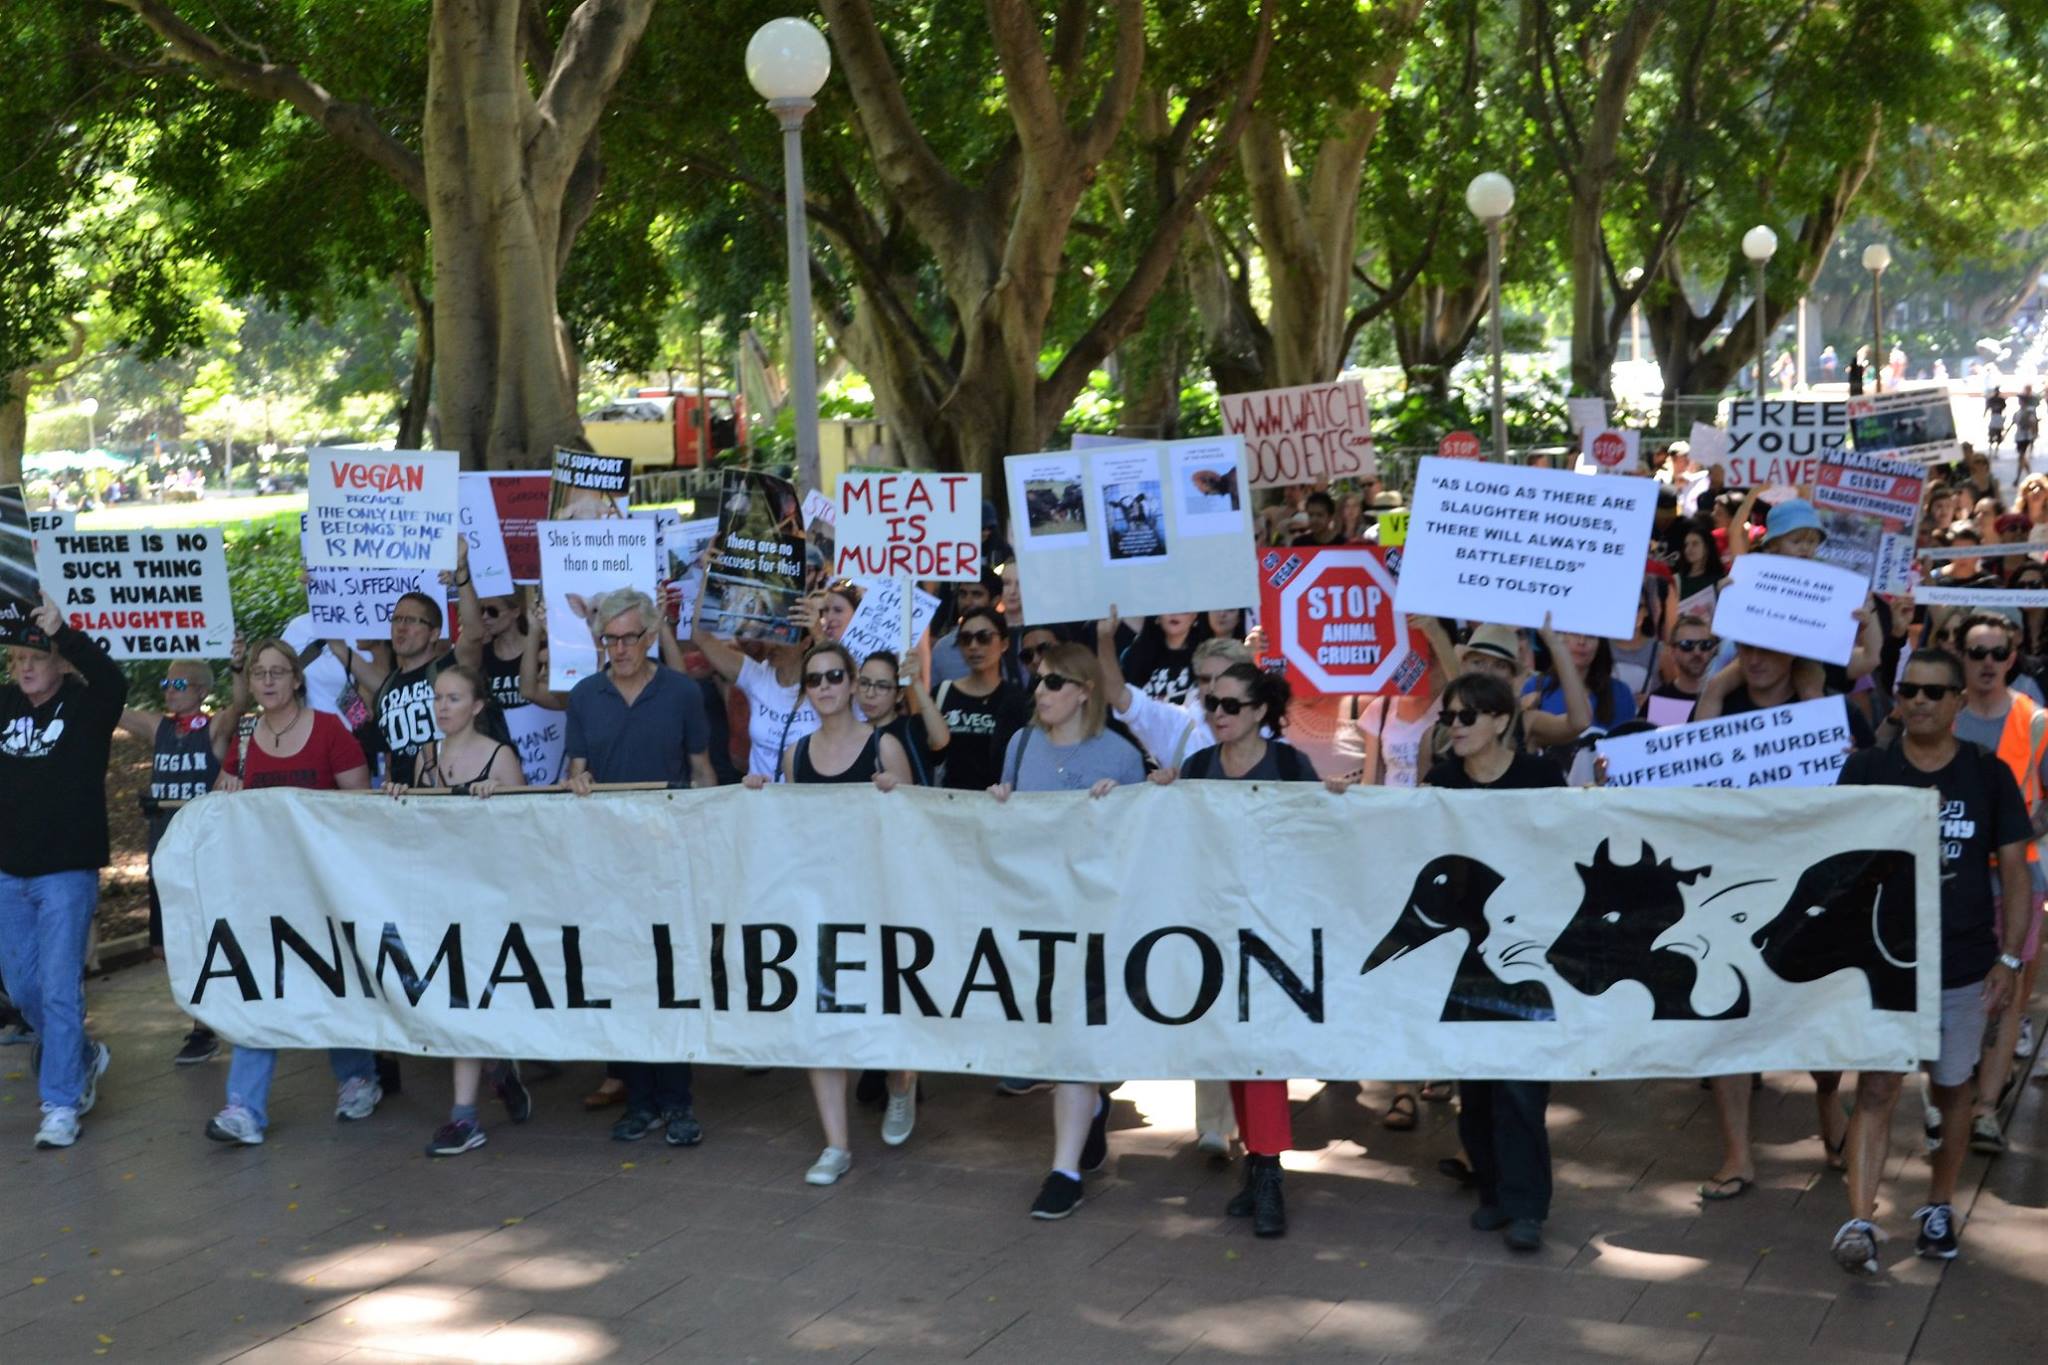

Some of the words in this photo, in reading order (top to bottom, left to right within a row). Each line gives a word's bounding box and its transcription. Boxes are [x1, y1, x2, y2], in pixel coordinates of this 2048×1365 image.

[1731, 402, 1846, 426] FREE
[571, 453, 623, 473] SUPPORT
[1847, 452, 1926, 479] MARCHING
[574, 471, 625, 490] SLAVERY
[1850, 474, 1887, 491] CLOSE
[843, 476, 968, 515] MEAT
[1465, 481, 1509, 497] LONG
[1515, 486, 1536, 500] AS
[1543, 490, 1596, 507] THERE
[1600, 497, 1636, 512] ARE
[317, 506, 344, 519] THE
[347, 508, 386, 522] ONLY
[424, 511, 454, 525] THAT
[1440, 500, 1539, 522] SLAUGHTER
[1545, 512, 1618, 534] HOUSES,
[321, 521, 395, 536] BELONGS
[420, 526, 444, 541] ME
[548, 530, 568, 548] She
[572, 531, 581, 546] is
[585, 529, 614, 546] much
[618, 534, 647, 546] more
[886, 514, 927, 544] IS
[1426, 521, 1479, 539] THERE
[1484, 528, 1522, 544] WILL
[1528, 535, 1597, 553] ALWAYS
[1603, 543, 1625, 556] BE
[55, 535, 129, 553] THERE
[141, 534, 164, 552] IS
[177, 533, 208, 552] NO
[326, 538, 346, 557] IS
[353, 538, 384, 560] MY
[386, 542, 432, 561] OWN
[727, 531, 755, 552] there
[758, 542, 776, 554] are
[778, 544, 793, 556] no
[63, 562, 122, 579] SUCH
[134, 560, 202, 578] THING
[564, 554, 587, 571] than
[592, 558, 598, 571] a
[602, 554, 633, 572] meal.
[719, 555, 755, 571] xcuses
[758, 554, 774, 572] for
[777, 557, 801, 576] this!
[837, 542, 978, 576] MURDER
[67, 587, 95, 605] AS
[111, 586, 203, 604] HUMANE
[1458, 572, 1490, 587] LEO
[1496, 577, 1573, 598] TOLSTOY
[1755, 582, 1777, 593] OUR
[1812, 582, 1835, 593] ARE
[311, 604, 350, 624] FEAR
[355, 601, 369, 626] &
[375, 603, 396, 623] DE
[1307, 586, 1382, 620] STOP
[69, 612, 206, 631] SLAUGHTER
[1322, 623, 1376, 643] ANIMAL
[124, 635, 200, 653] VEGAN
[1317, 646, 1382, 665] CRUELTY
[1645, 715, 1765, 755] SUFFERING
[1772, 709, 1793, 728] IS
[1607, 752, 1723, 788] SUFFERING
[1732, 747, 1748, 763] &
[1754, 726, 1846, 759] MURDER
[1748, 764, 1793, 788] AND
[1798, 752, 1844, 776] THE
[190, 915, 612, 1010] ANIMAL
[652, 922, 1325, 1026] LIBERATION
